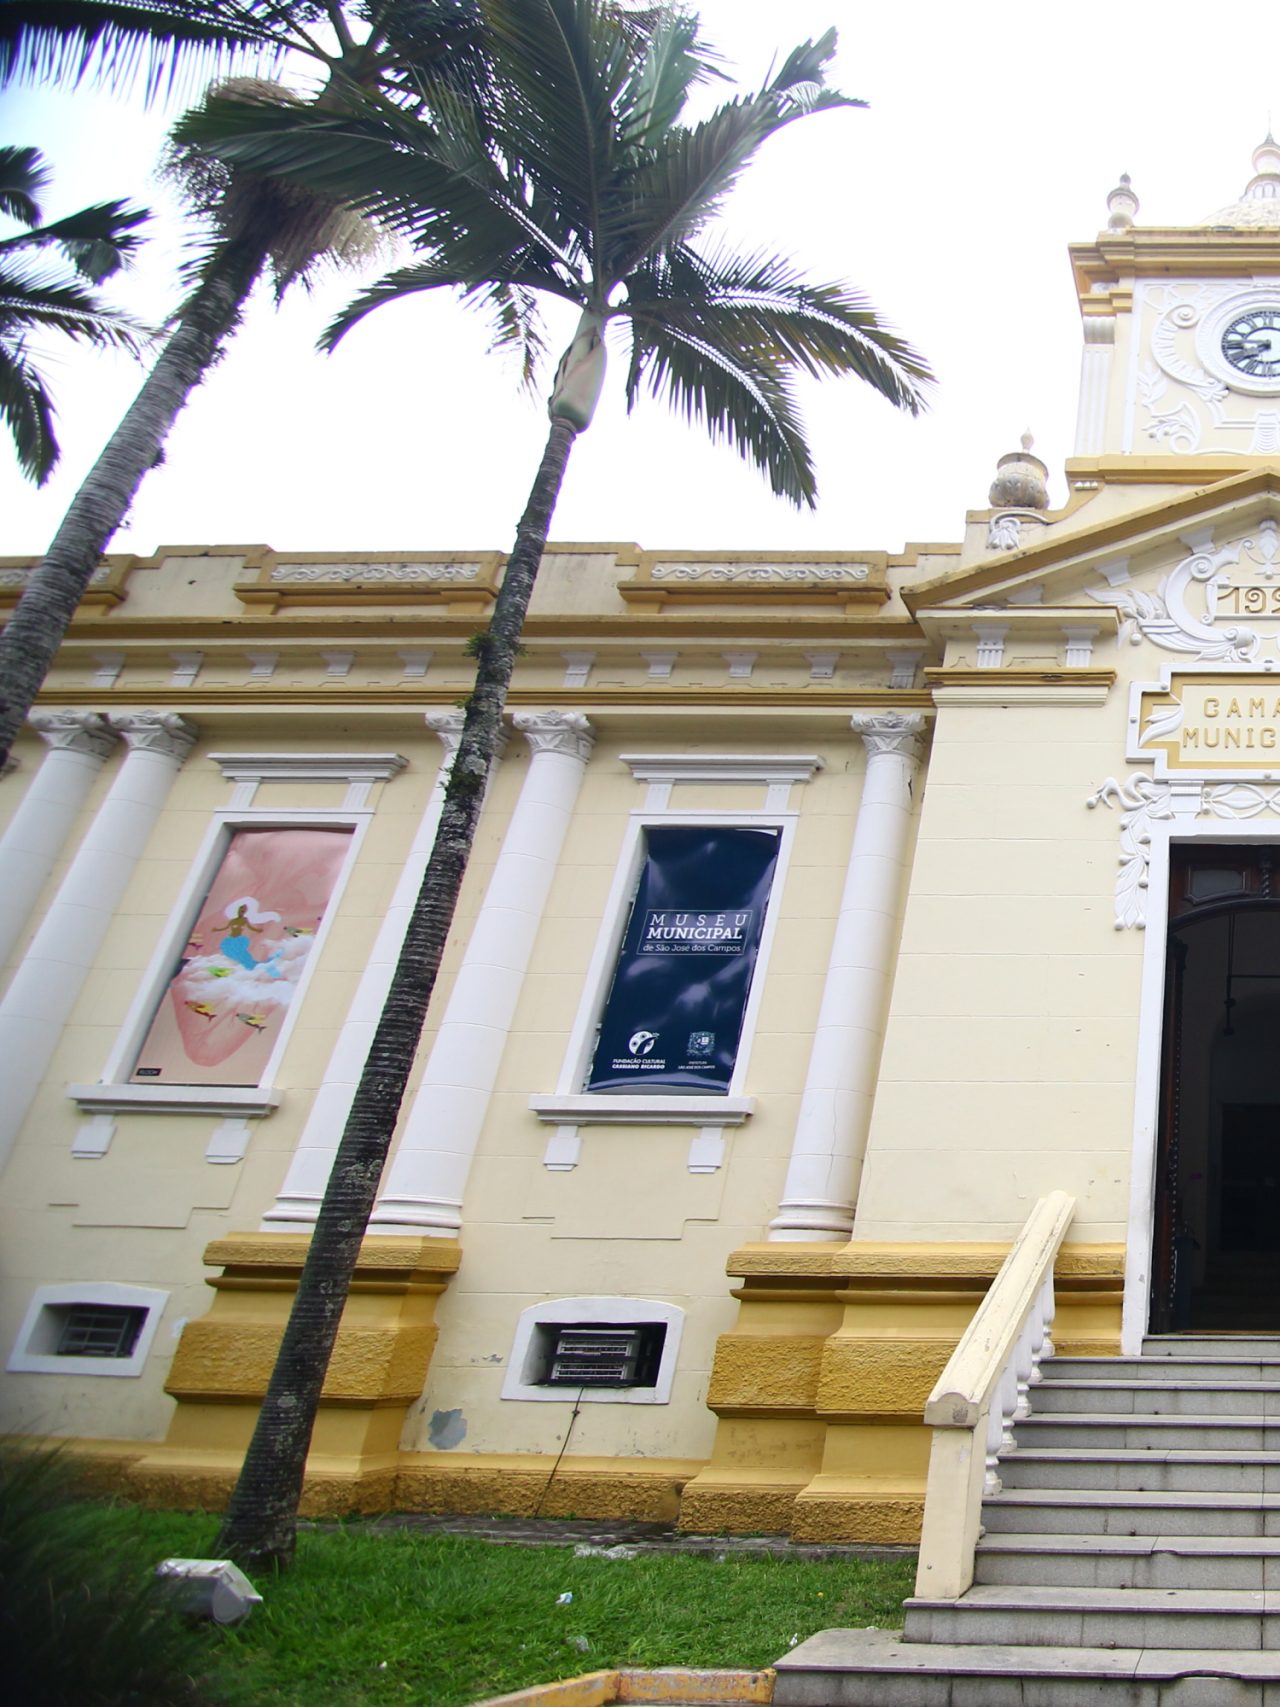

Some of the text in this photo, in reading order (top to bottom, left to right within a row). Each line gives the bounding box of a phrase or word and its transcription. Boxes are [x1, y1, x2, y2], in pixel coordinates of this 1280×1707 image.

[649, 914, 748, 926] MUSEU
[646, 927, 743, 939] MUNICIPAL
[643, 944, 741, 953] de São José dos Campos
